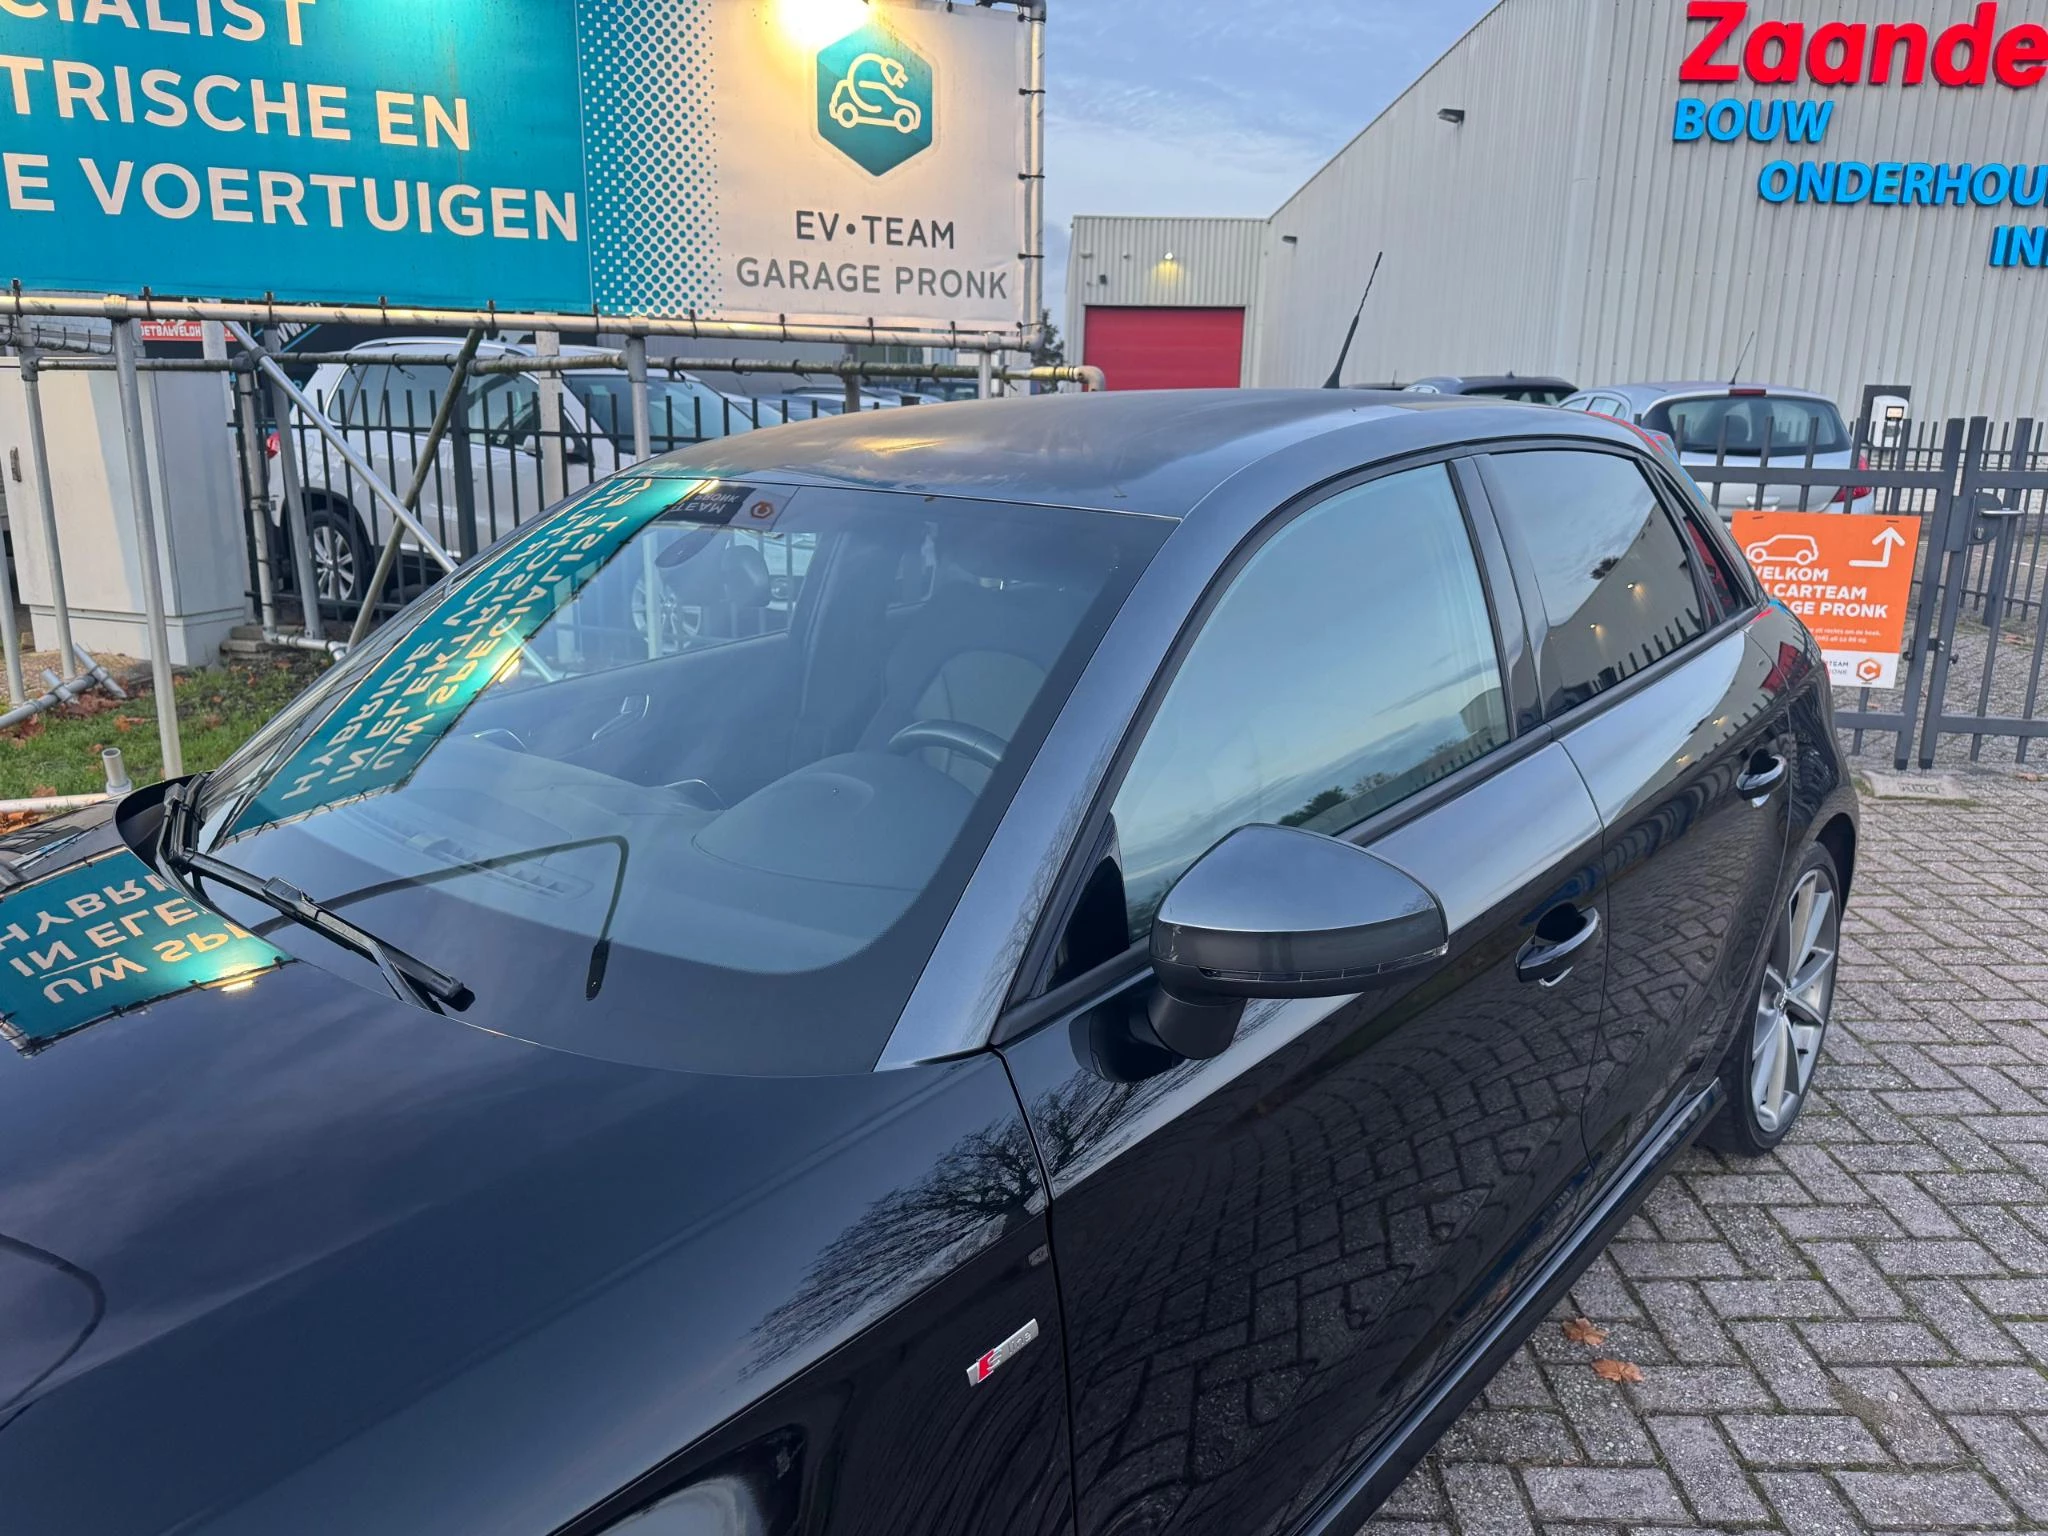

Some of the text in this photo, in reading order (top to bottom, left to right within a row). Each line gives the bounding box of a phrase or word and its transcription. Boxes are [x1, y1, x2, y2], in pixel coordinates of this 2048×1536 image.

[1679, 0, 2048, 89] Zaande
[0, 54, 471, 151] TRISCHE EN
[1672, 98, 1834, 143] BOUW
[2, 152, 578, 242] E VOERTUIGEN
[736, 256, 1008, 299] GARAGE PRONK
[1773, 583, 1867, 600] CARTEAM
[1819, 602, 1888, 618] PRONK
